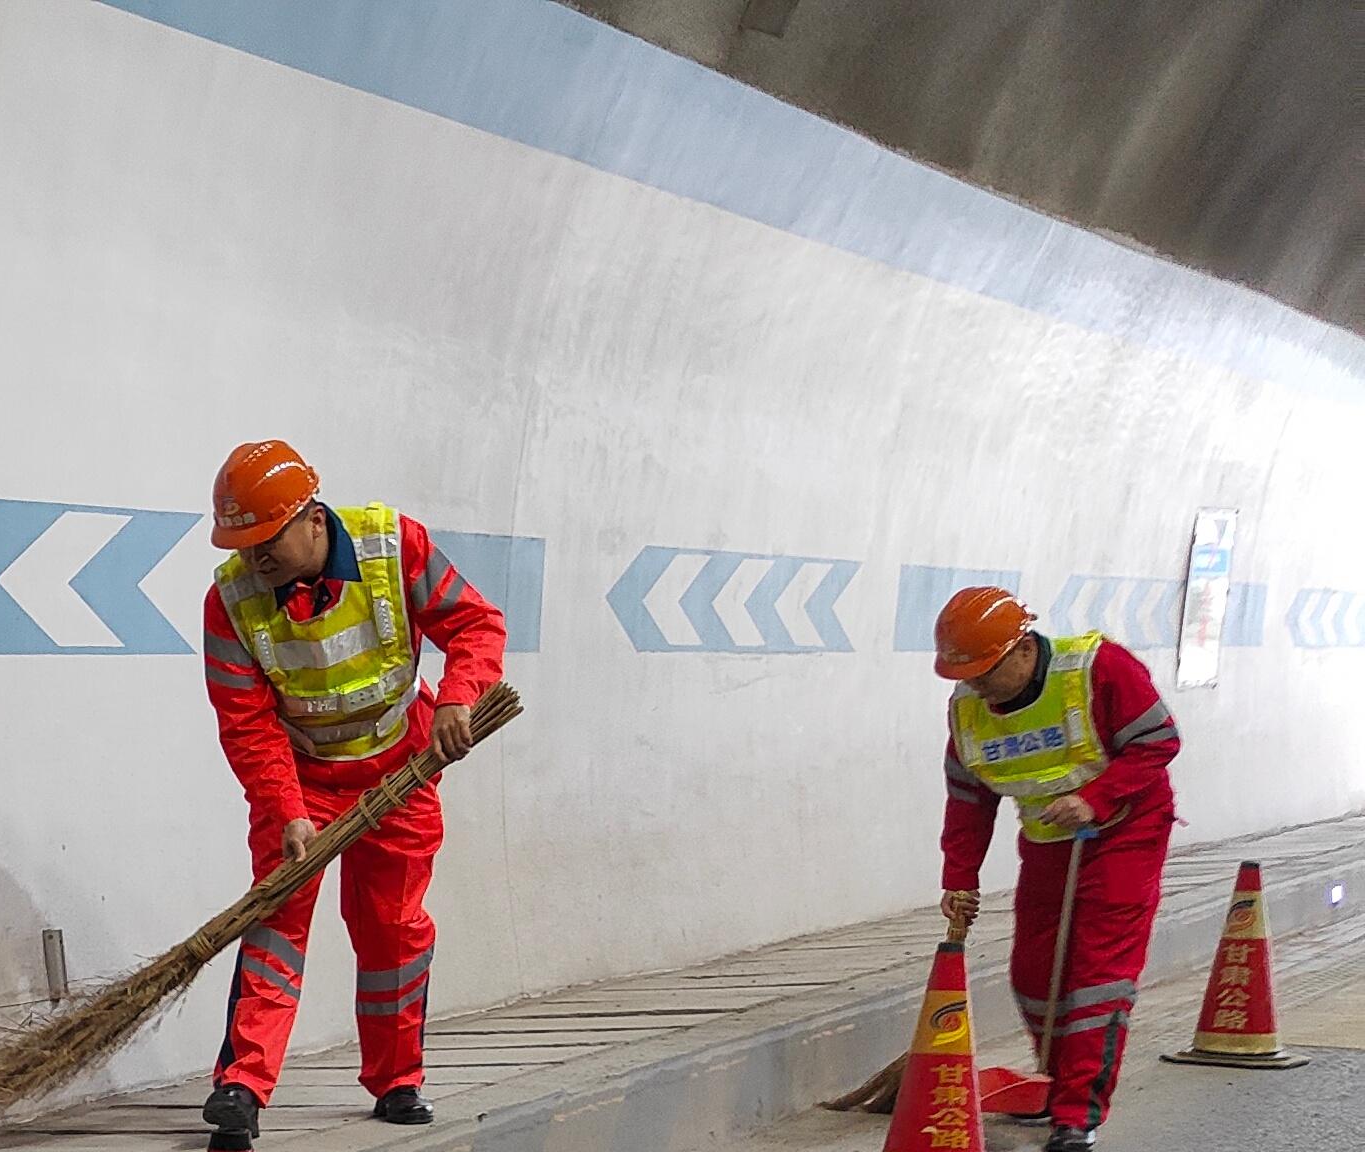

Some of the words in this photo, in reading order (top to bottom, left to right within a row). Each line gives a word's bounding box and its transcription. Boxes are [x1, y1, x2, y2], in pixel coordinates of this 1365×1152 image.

[1212, 943, 1257, 1030] 甘肃公路
[928, 1063, 971, 1149] 甘肃公路
